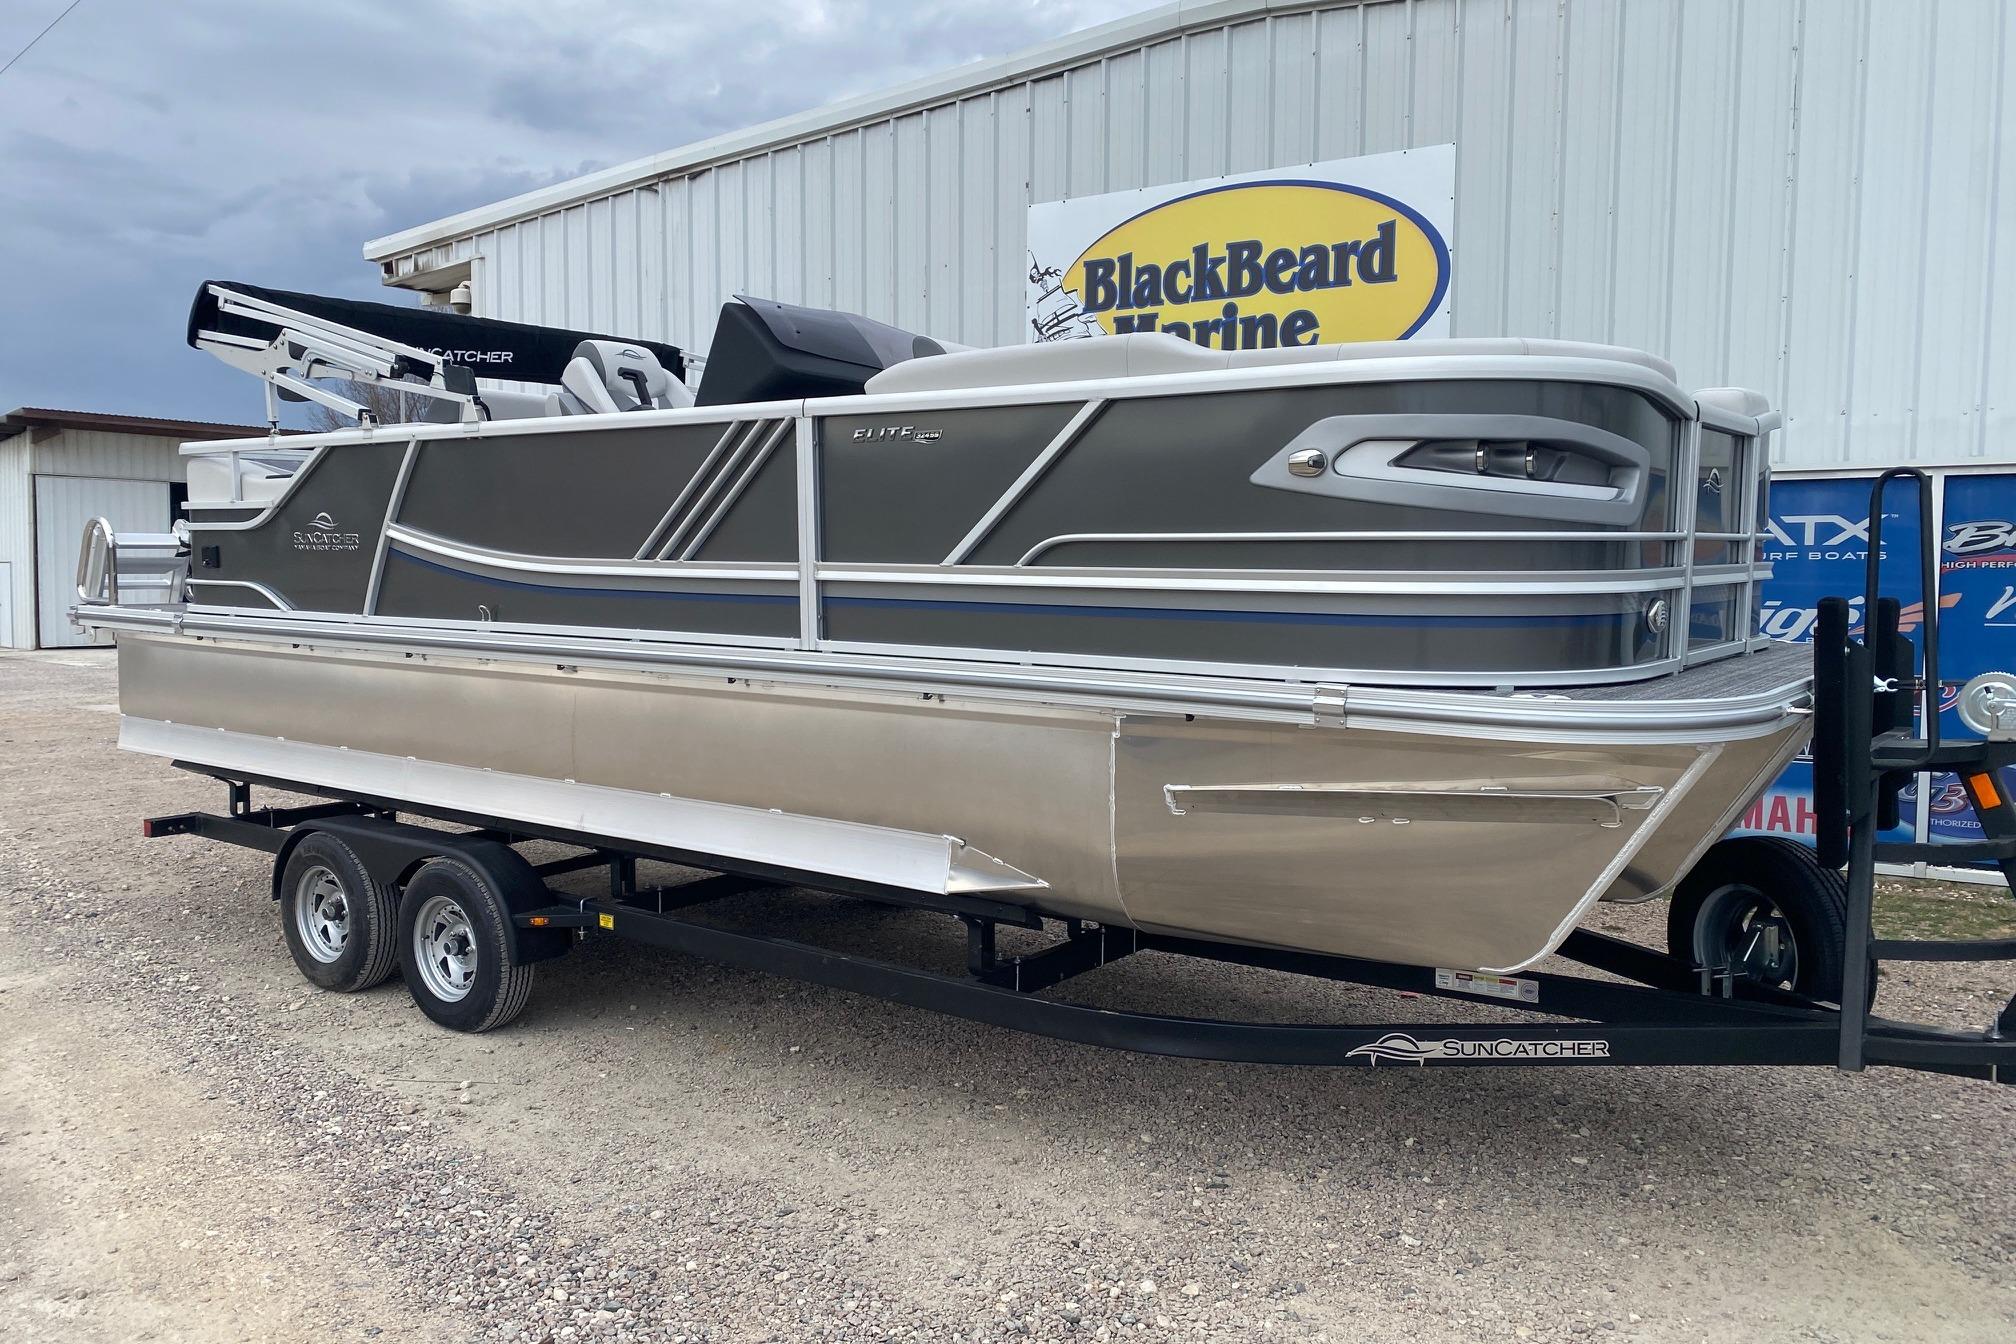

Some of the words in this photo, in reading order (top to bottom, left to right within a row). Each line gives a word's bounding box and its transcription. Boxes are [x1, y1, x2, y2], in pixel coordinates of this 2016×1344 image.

[1083, 219, 1398, 314] BlackBeard
[416, 346, 514, 363] CATCHER
[853, 426, 914, 443] ELITE
[1763, 552, 1799, 560] RF
[1738, 795, 1817, 834] MAH
[1931, 818, 1981, 829] THORIZED
[1443, 1040, 1608, 1056] SUNCATCHER
